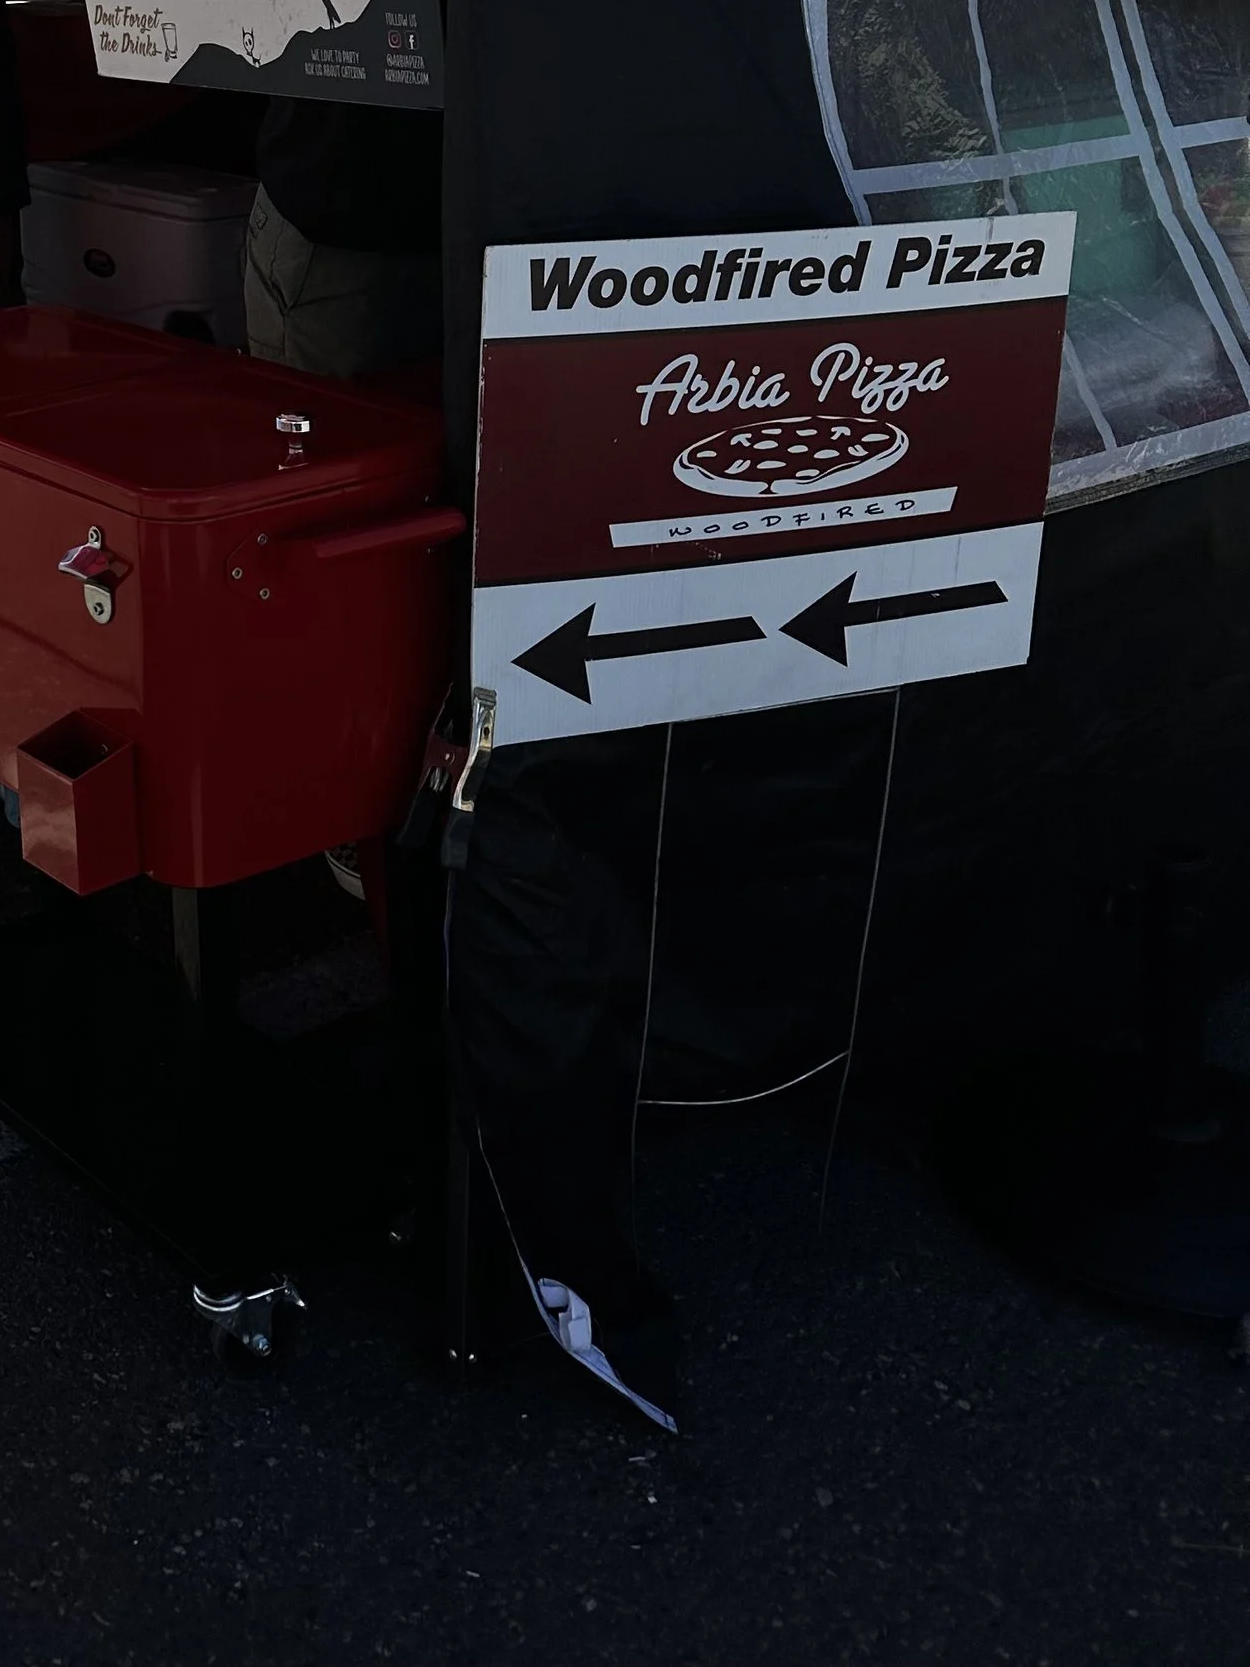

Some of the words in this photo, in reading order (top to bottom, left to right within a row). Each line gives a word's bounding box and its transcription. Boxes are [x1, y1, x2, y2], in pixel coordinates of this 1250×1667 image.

[123, 6, 163, 34] Forget
[408, 14, 417, 28] US
[100, 32, 118, 53] the
[121, 32, 162, 57] Drinks
[530, 242, 871, 311] Woodfired
[886, 236, 1046, 290] Pizza
[636, 353, 790, 426] Arbia
[810, 342, 949, 413] Pizza
[668, 499, 916, 538] WOODFIRED
